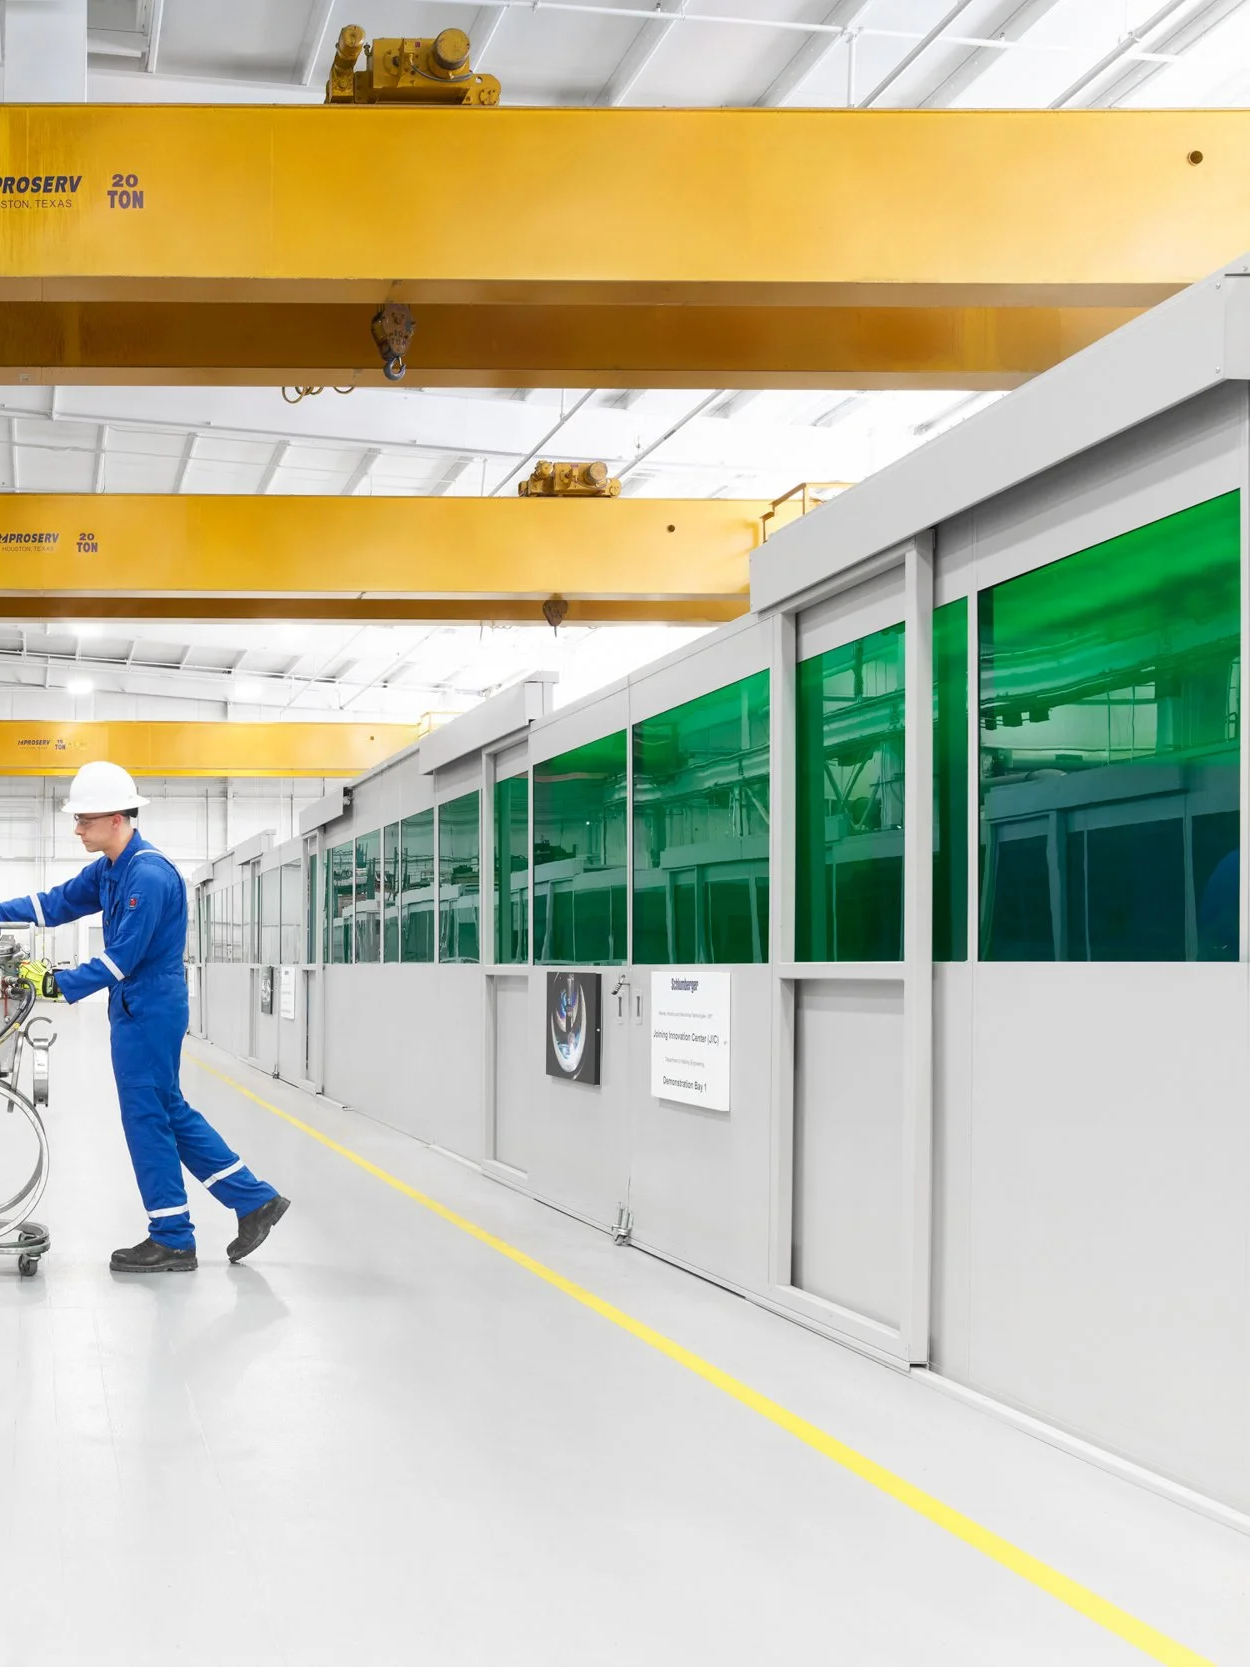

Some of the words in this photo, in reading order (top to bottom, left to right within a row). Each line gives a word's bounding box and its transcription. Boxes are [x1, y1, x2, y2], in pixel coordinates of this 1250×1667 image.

[111, 174, 139, 188] 20
[35, 199, 72, 208] TEXAS
[107, 190, 144, 209] TON
[79, 532, 95, 541] 20
[76, 542, 98, 553] TON
[671, 978, 699, 993] Schlumberger
[653, 1030, 668, 1041] Joining
[668, 1031, 690, 1042] Innovation
[691, 1033, 707, 1044] Center
[662, 1075, 694, 1090] Demonstration
[694, 1081, 703, 1093] Bay
